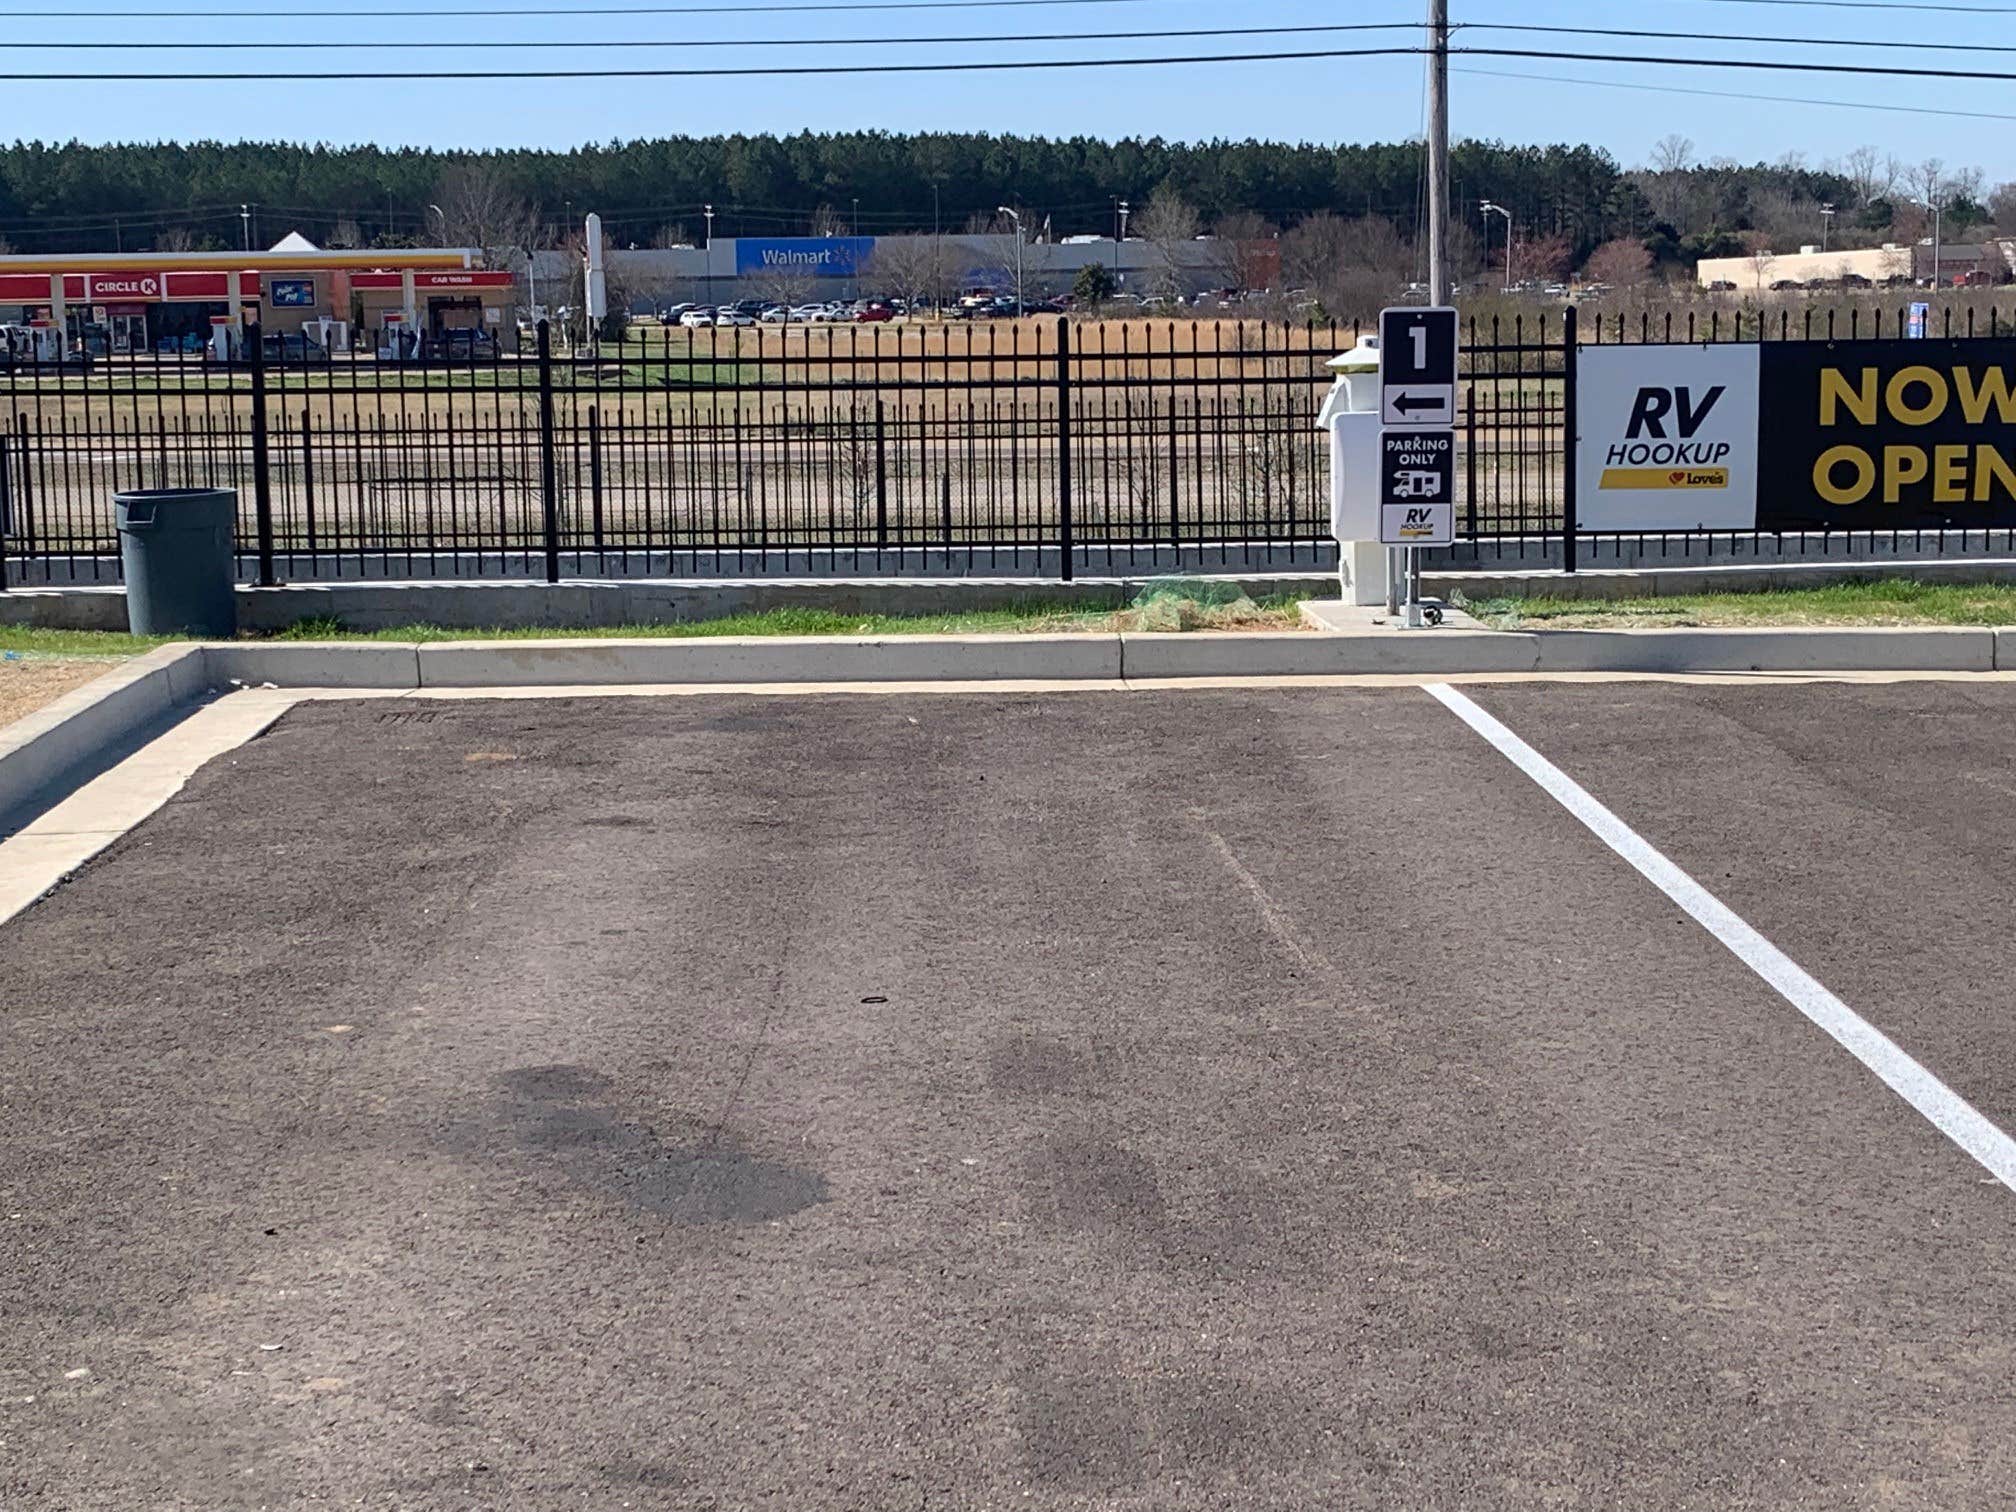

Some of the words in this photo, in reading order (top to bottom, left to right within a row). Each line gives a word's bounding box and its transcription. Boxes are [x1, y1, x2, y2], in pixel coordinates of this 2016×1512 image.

[762, 249, 831, 265] Walmart
[95, 282, 139, 293] CIRCLE
[141, 279, 157, 295] K
[1409, 326, 1426, 369] 1
[1820, 366, 2016, 426] NOW
[1625, 386, 1727, 439] RV
[1387, 439, 1449, 451] PARKING
[1399, 454, 1436, 465] ONLY
[1606, 443, 1730, 465] HOOKUP
[1687, 472, 1724, 485] Love's
[1813, 445, 2016, 505] OPEN
[1407, 508, 1432, 523] RV
